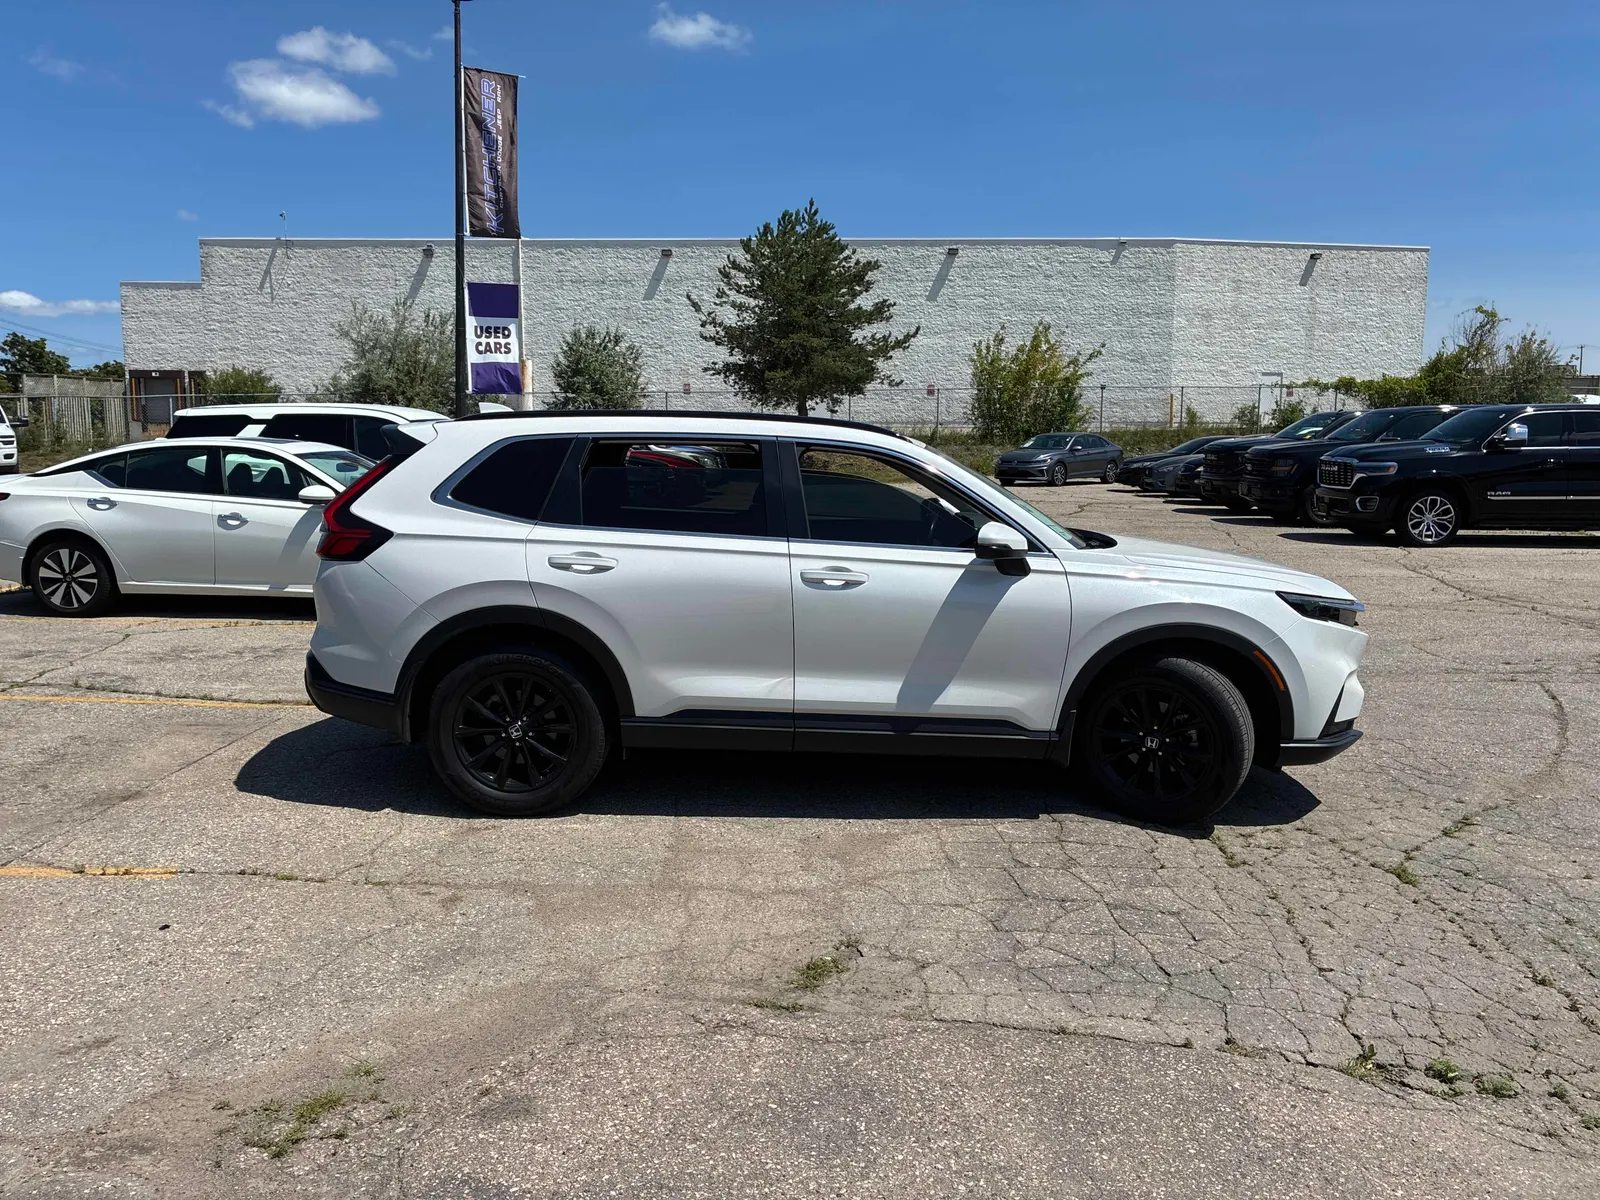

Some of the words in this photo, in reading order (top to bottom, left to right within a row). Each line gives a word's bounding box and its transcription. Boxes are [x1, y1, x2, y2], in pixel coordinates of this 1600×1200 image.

[481, 78, 504, 233] KITCHENER
[474, 325, 512, 339] USED
[474, 341, 512, 355] CARS
